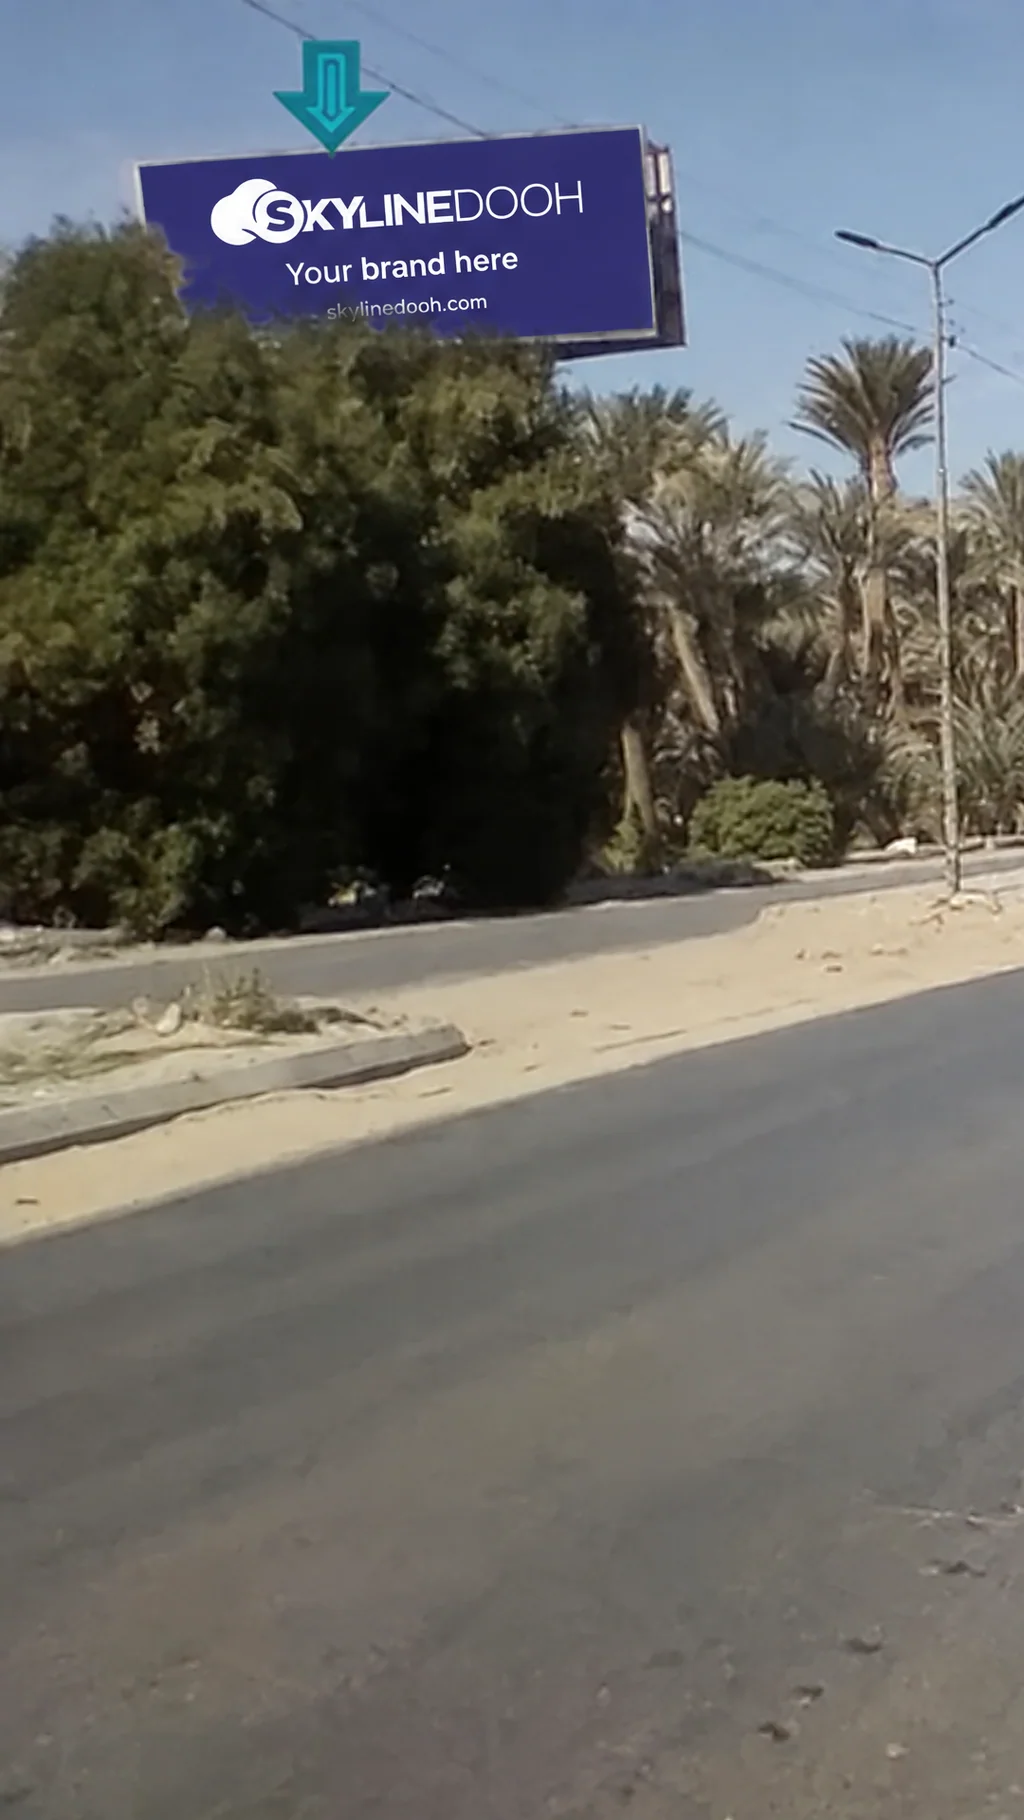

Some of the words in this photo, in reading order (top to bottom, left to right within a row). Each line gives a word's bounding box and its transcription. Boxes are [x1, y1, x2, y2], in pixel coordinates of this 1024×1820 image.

[265, 180, 584, 233] SKYLINEDOOH
[285, 262, 353, 286] Your
[360, 251, 446, 281] brand
[454, 249, 519, 273] here
[326, 296, 488, 322] skylinedooh.com
